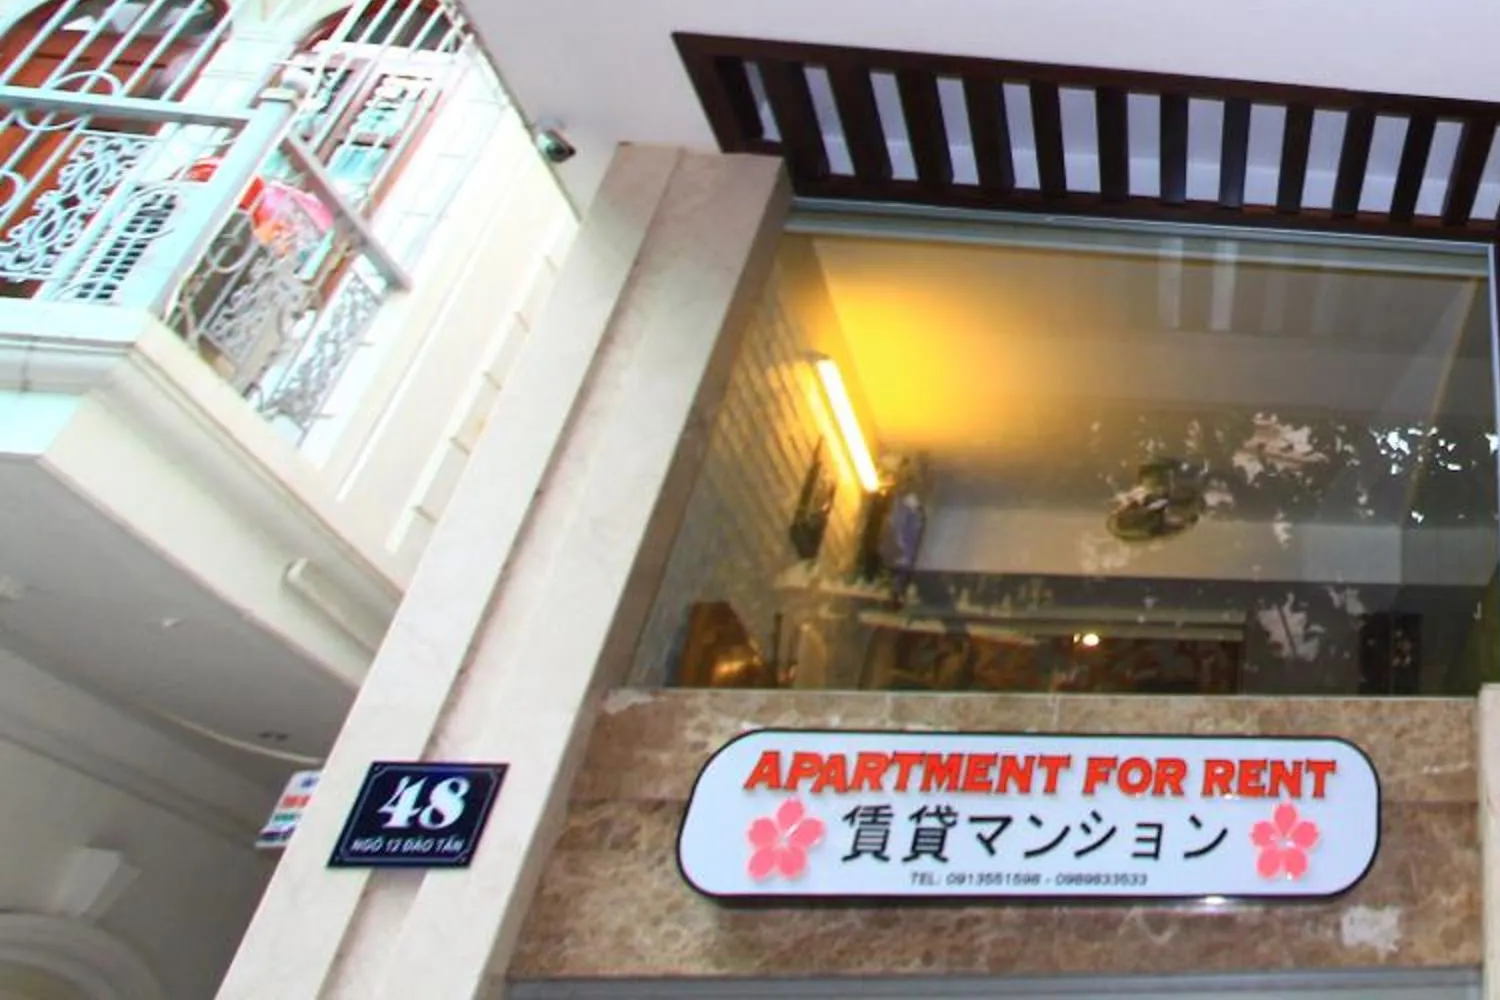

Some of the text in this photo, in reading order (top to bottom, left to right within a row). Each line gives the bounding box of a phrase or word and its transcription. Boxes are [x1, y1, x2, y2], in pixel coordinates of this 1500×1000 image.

[743, 750, 1337, 799] APARTMENT FOR RENT
[378, 776, 471, 830] 48
[386, 838, 402, 852] 12
[840, 804, 1229, 863] 賃貸マンション
